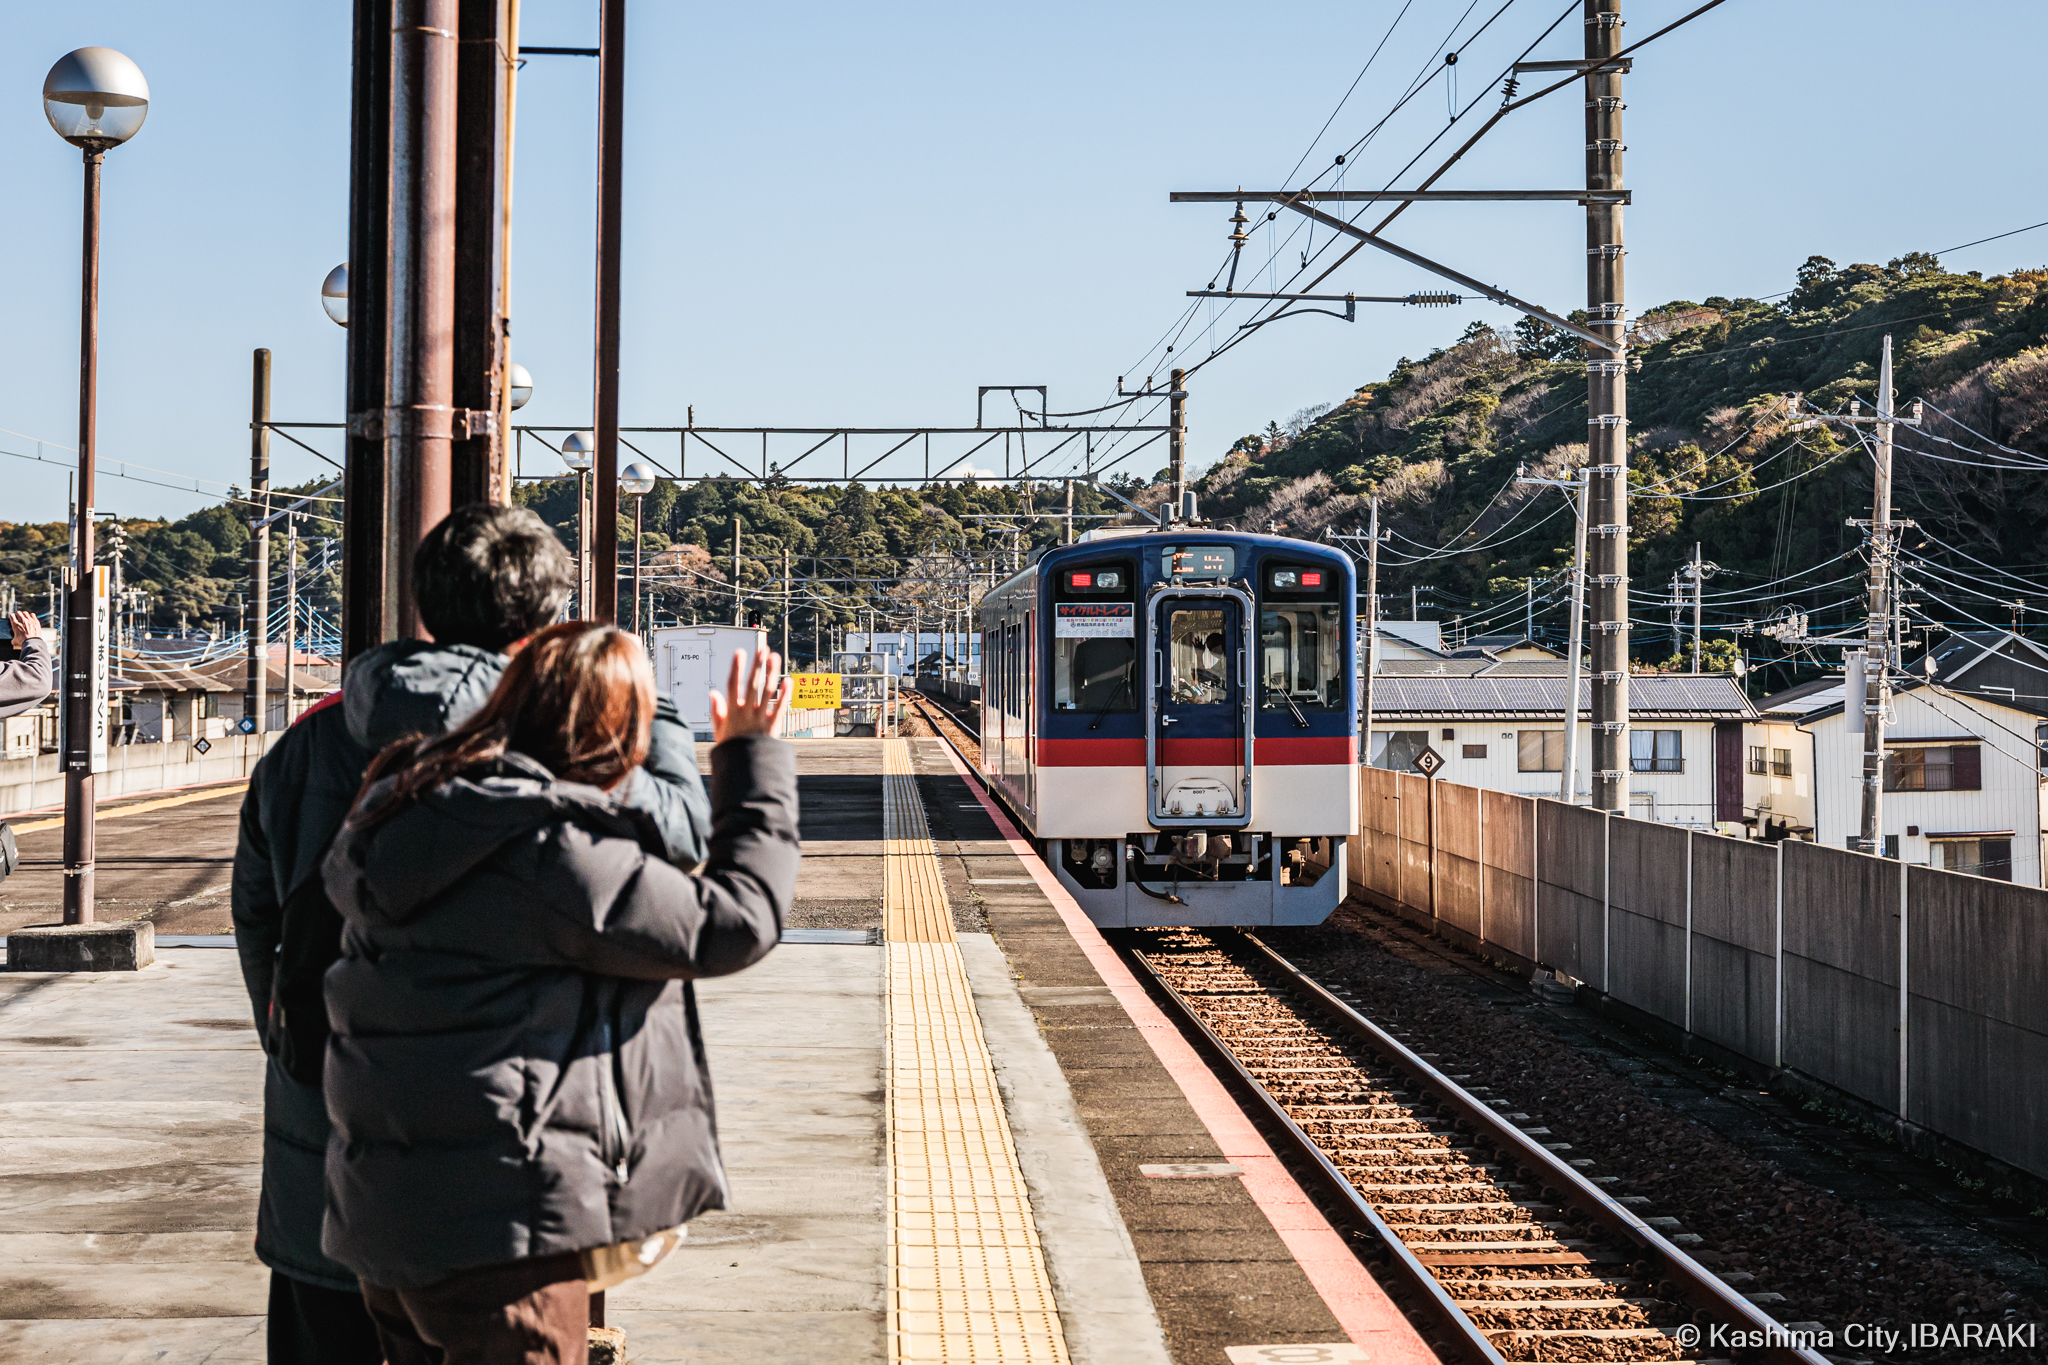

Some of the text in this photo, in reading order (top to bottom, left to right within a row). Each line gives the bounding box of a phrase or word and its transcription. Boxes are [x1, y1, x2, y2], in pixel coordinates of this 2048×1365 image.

[1059, 605, 1130, 616] サイクルトレイン
[97, 605, 106, 739] かしまじんぐう
[799, 677, 834, 686] きけん
[1424, 756, 1433, 769] 9
